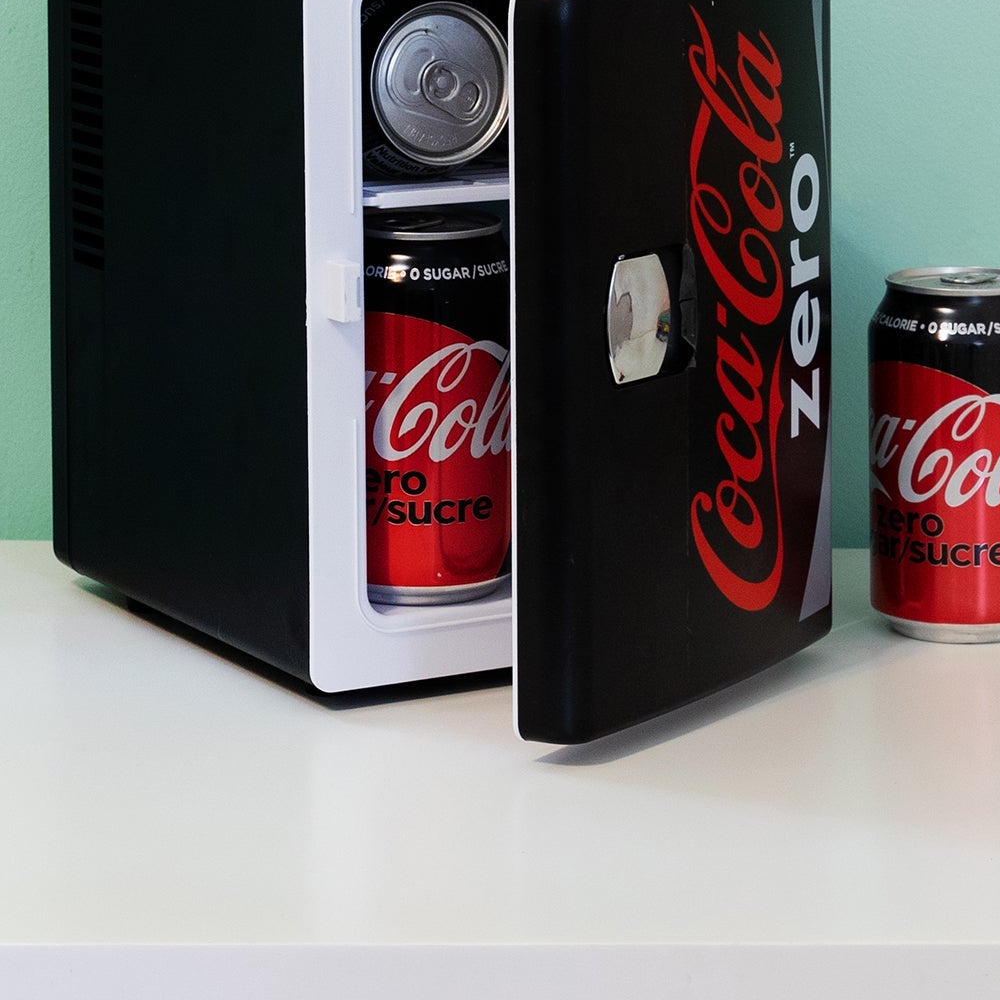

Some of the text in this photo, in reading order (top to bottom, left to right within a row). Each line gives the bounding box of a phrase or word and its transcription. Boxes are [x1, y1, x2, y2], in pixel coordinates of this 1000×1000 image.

[688, 4, 784, 612] Coca-Cola
[790, 153, 821, 439] zero
[366, 467, 428, 496] ero
[877, 505, 945, 538] zero
